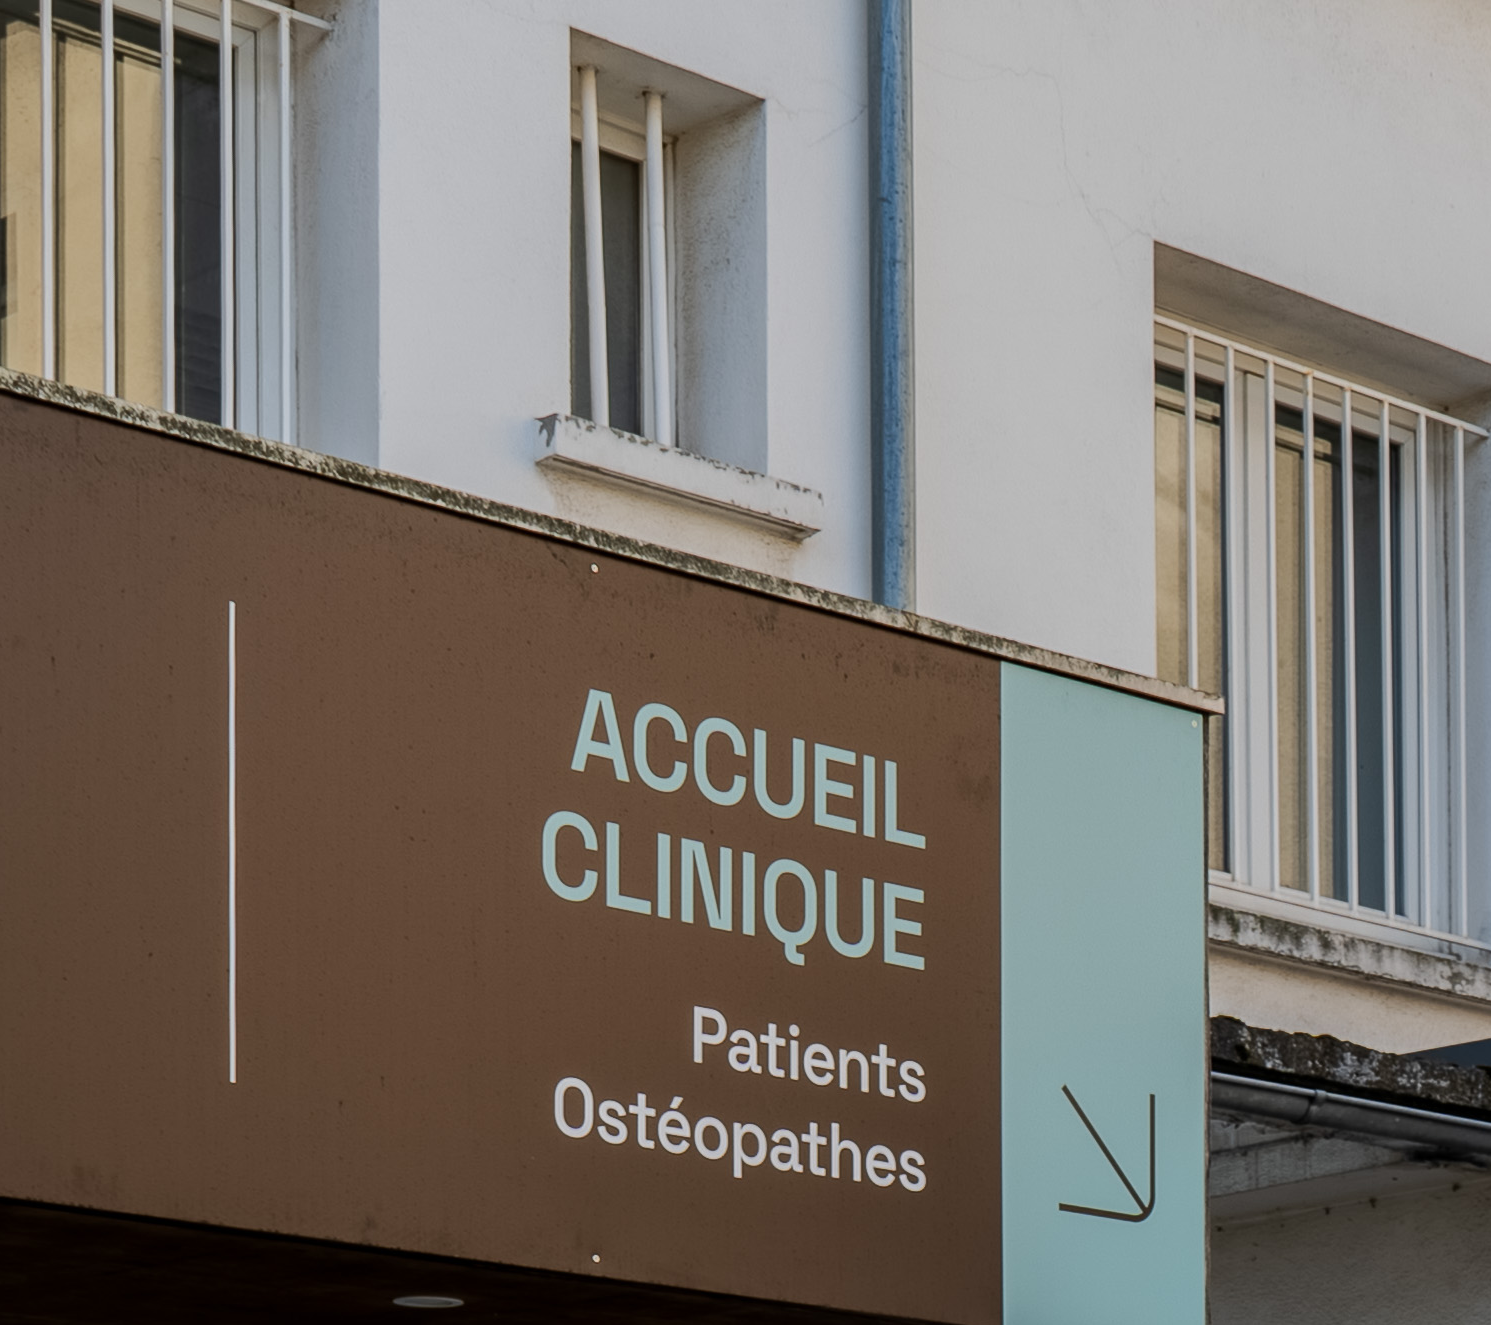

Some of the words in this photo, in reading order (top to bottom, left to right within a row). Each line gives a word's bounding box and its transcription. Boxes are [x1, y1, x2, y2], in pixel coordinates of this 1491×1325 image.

[570, 688, 926, 849] ACCUEIL
[541, 810, 925, 970] CLINIQUE
[693, 1005, 926, 1102] Patients
[553, 1077, 927, 1191] Ostéopathes
